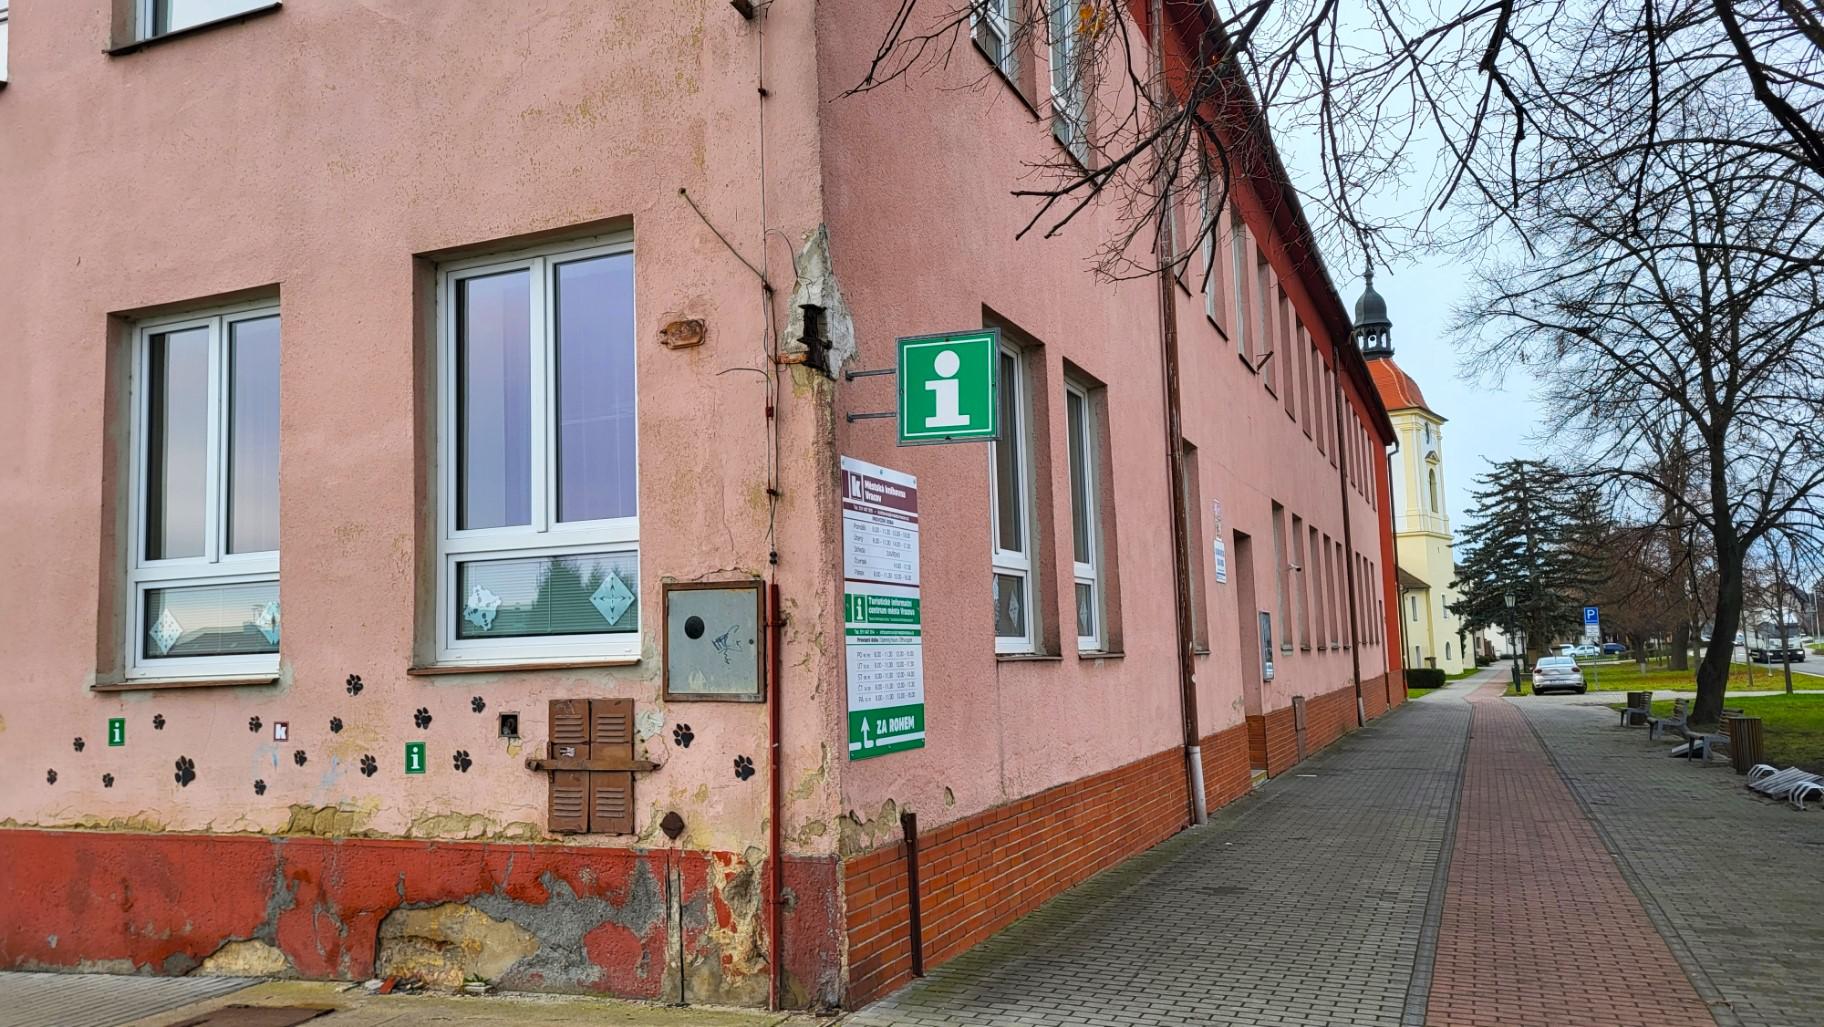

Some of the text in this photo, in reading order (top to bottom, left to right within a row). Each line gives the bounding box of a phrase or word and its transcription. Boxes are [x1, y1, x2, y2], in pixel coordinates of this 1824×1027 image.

[925, 349, 971, 428] i
[1587, 609, 1595, 619] P
[876, 715, 915, 735] ZA ROHEM
